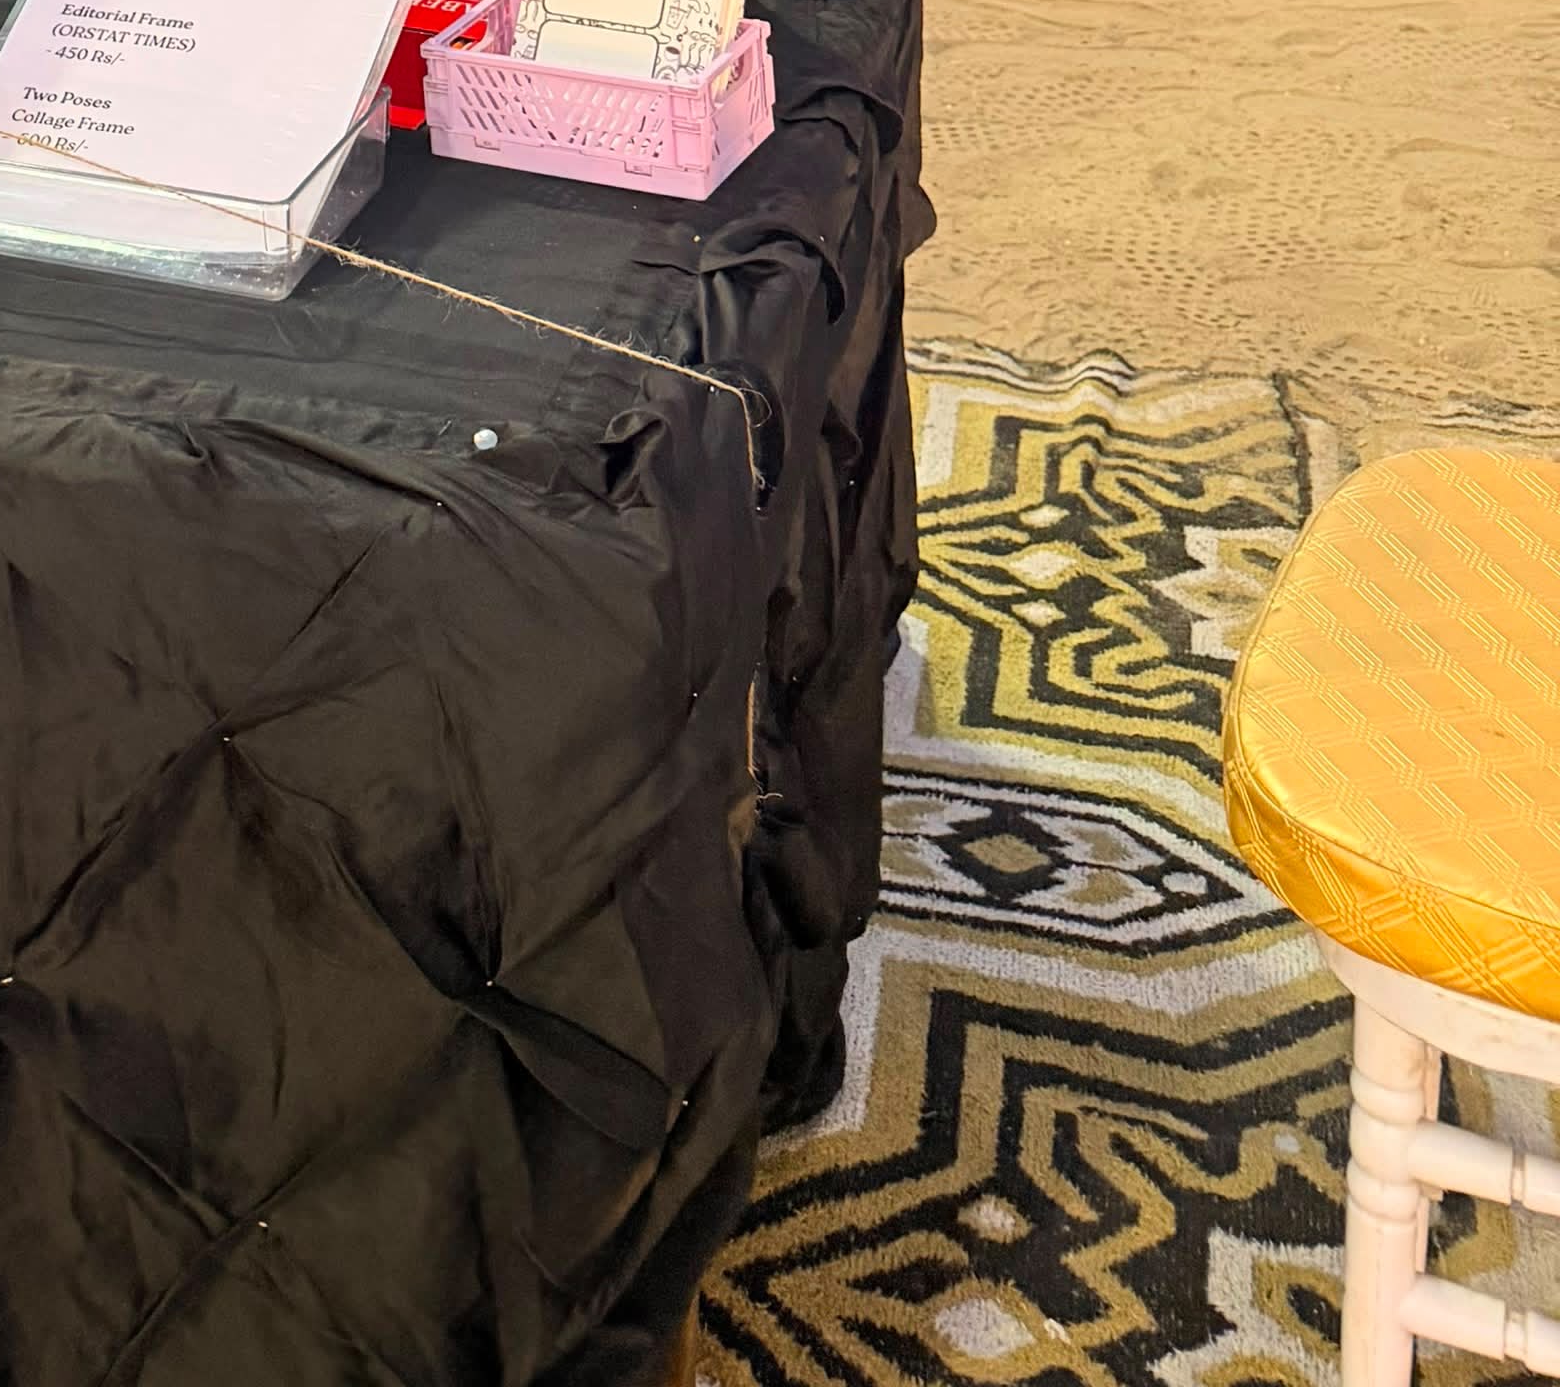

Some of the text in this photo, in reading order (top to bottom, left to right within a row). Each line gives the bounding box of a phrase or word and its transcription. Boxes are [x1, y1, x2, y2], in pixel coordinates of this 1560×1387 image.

[61, 3, 195, 30] Editorial Frame
[52, 23, 196, 53] (ORSTAT TIMES)
[55, 46, 89, 61] 450
[90, 49, 126, 66] Rs/-
[23, 86, 112, 109] Two Poses
[12, 108, 135, 136] Collage Frame
[54, 136, 89, 153] Rs/-
